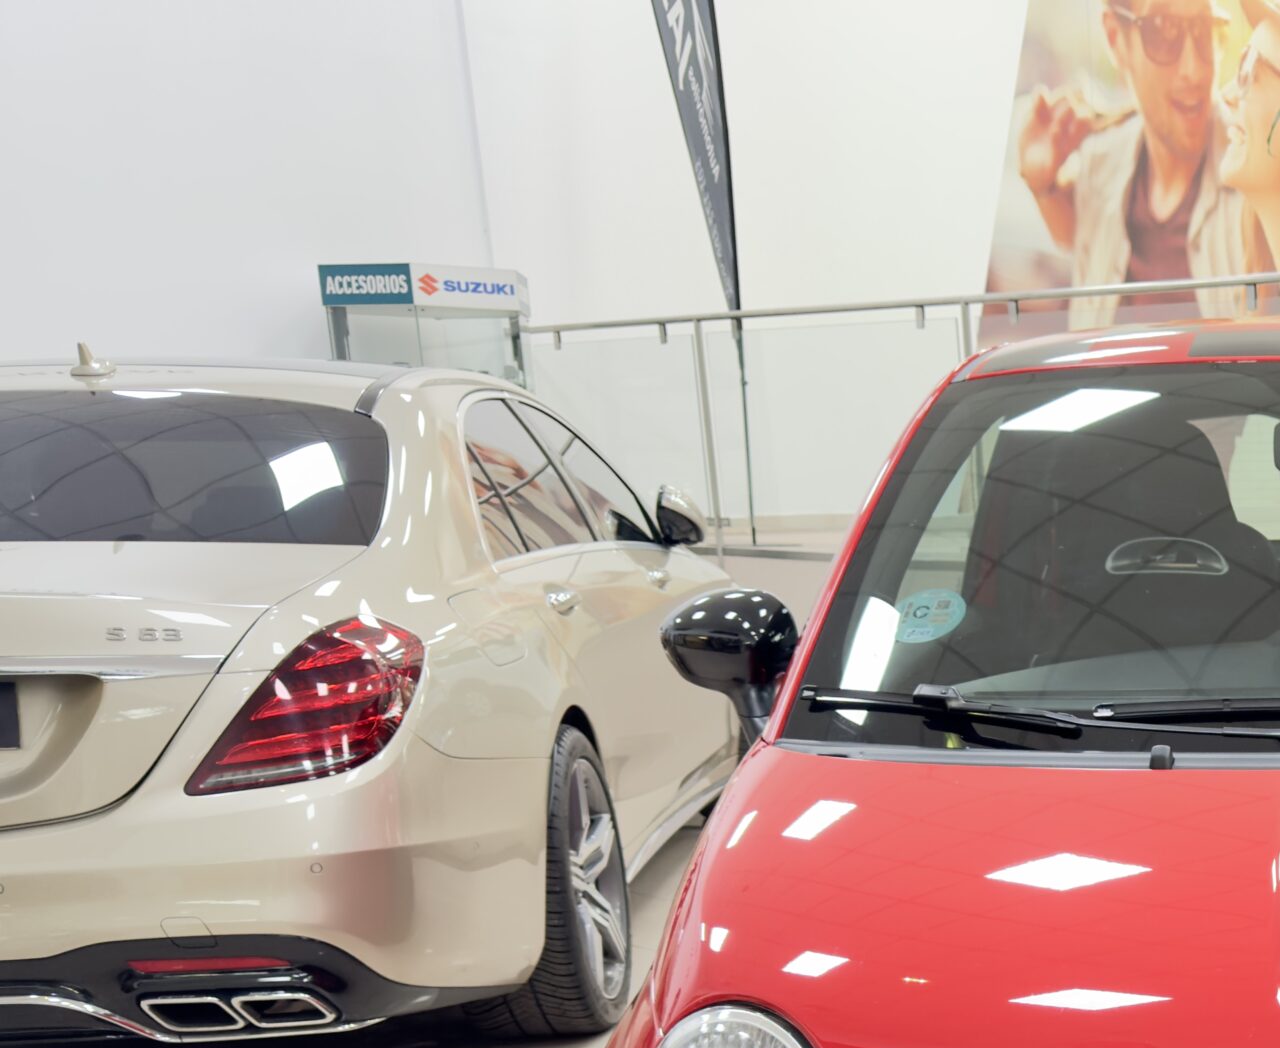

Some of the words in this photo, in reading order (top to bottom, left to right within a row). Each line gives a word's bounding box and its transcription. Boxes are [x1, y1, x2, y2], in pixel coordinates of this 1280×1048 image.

[326, 274, 408, 295] ACCESORIOS
[443, 280, 515, 296] SUZUKI
[105, 626, 127, 642] S
[138, 626, 183, 642] 63
